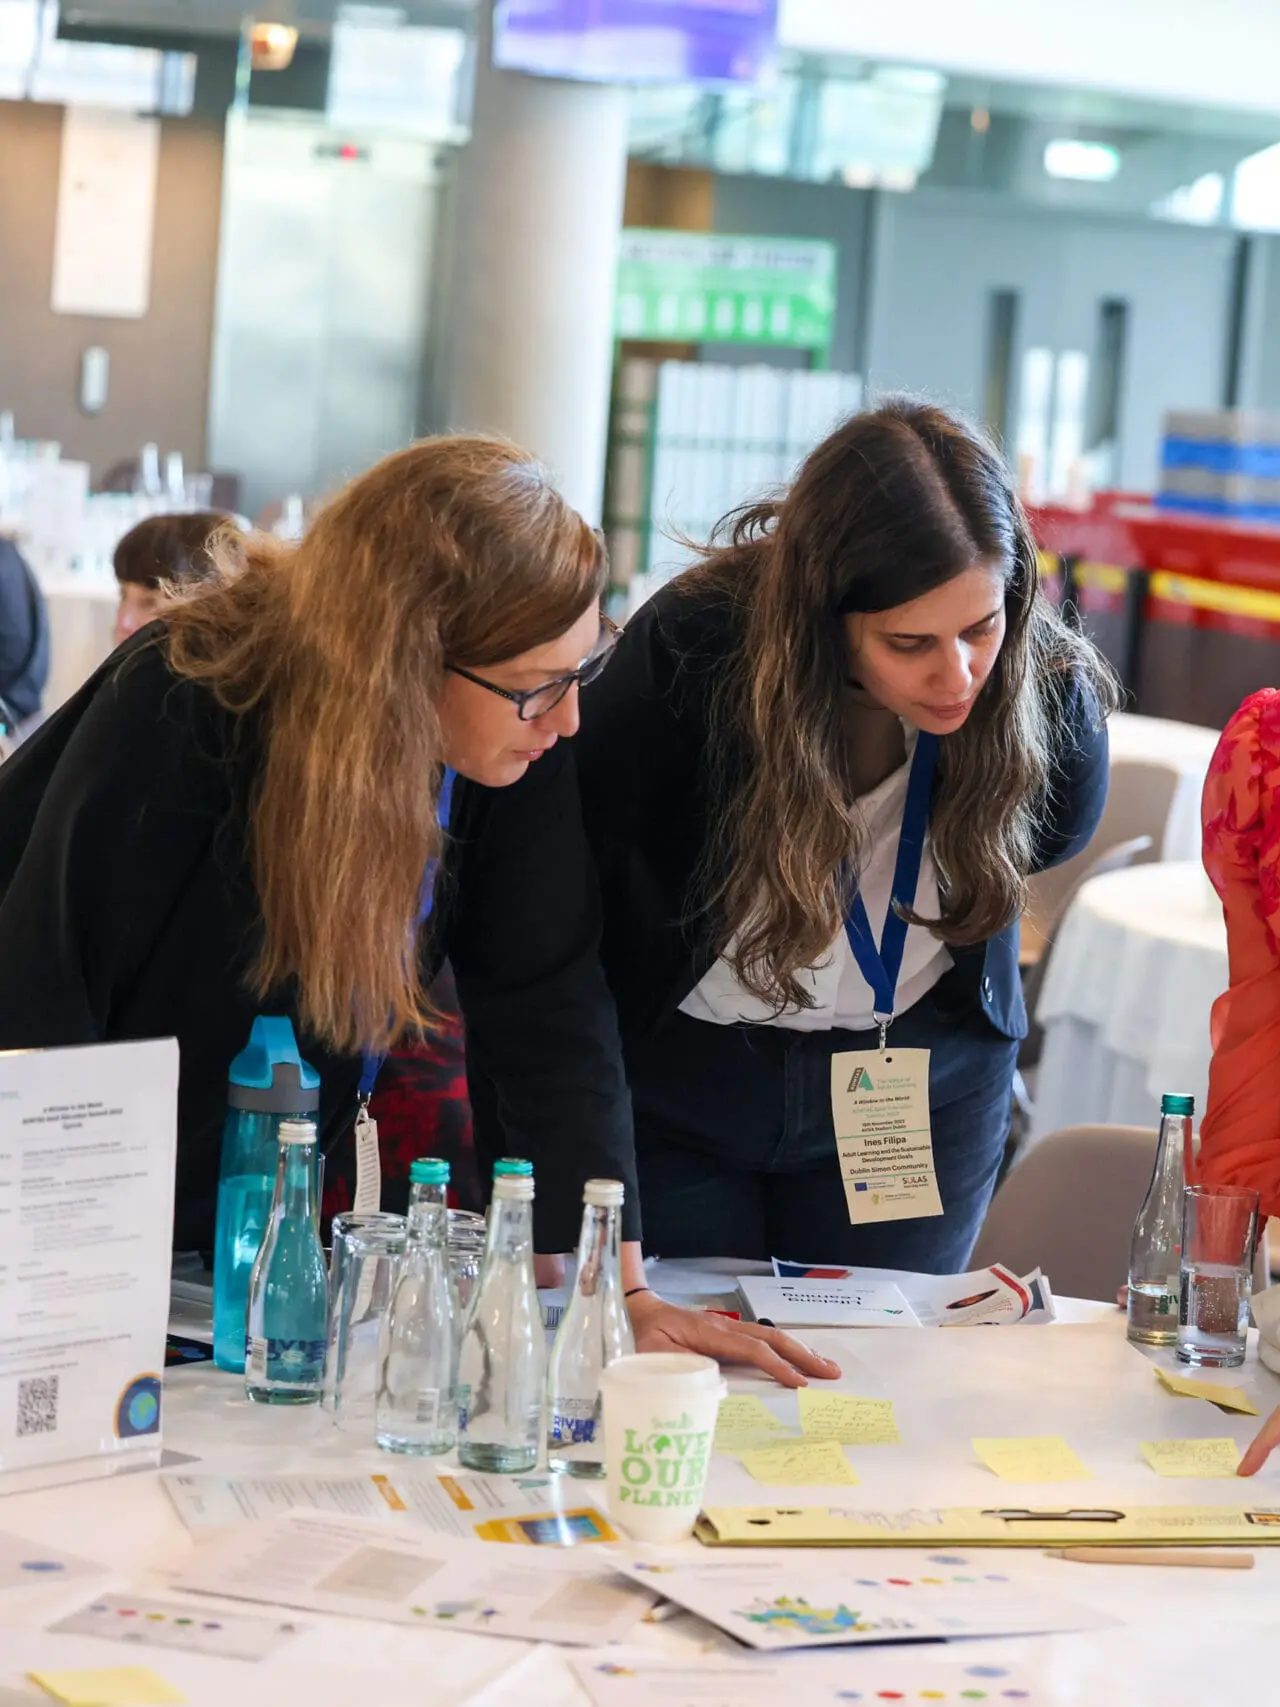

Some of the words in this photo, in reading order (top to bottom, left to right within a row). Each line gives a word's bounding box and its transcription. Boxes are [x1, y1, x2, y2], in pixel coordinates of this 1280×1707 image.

[864, 1139, 882, 1147] Ines
[883, 1136, 907, 1145] Filipa
[862, 1155, 897, 1163] Development
[850, 1167, 870, 1175] Dublin
[892, 1163, 928, 1171] Community
